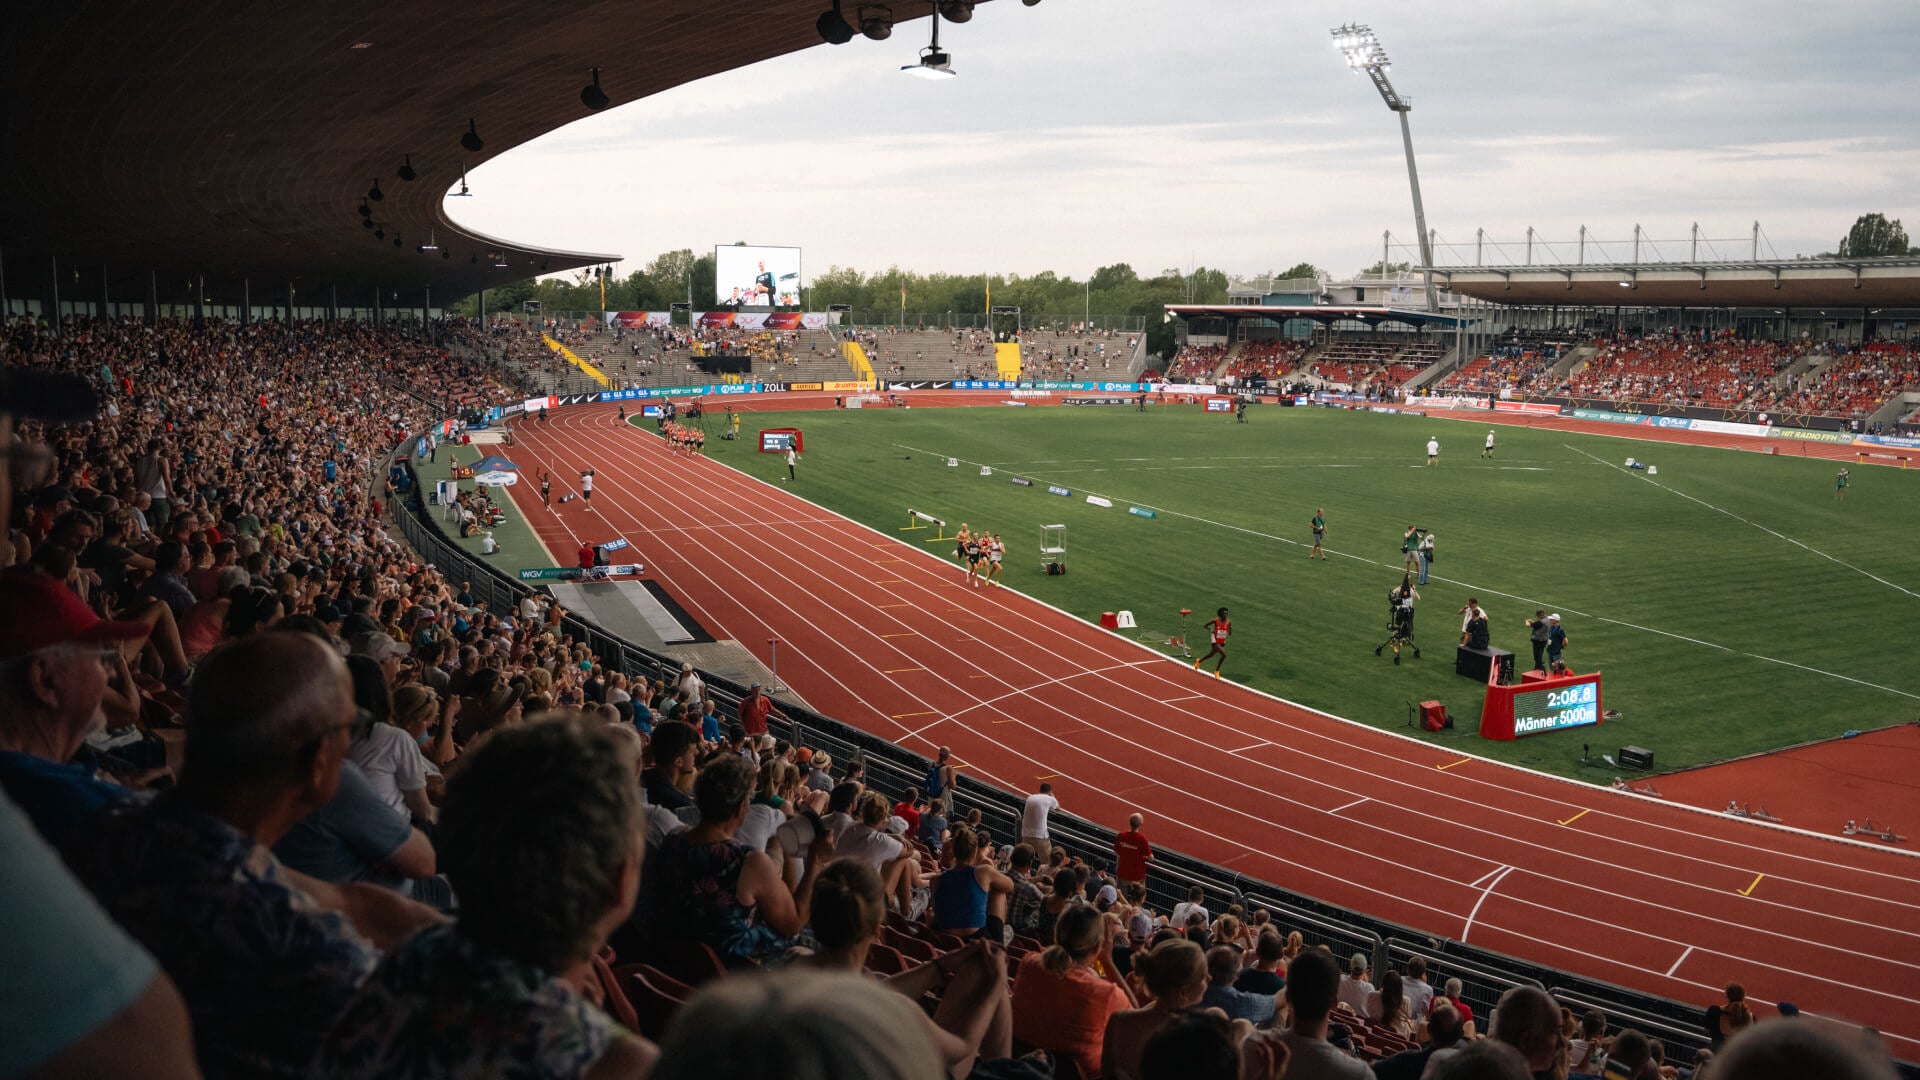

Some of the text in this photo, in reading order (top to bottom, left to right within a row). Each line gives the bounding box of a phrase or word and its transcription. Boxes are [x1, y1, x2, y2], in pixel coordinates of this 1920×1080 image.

[764, 383, 786, 392] ZOLL
[1794, 431, 1821, 439] RADIO
[1821, 433, 1838, 441] FFH
[521, 570, 543, 578] WGV
[1515, 706, 1594, 733] Männer 5000m
